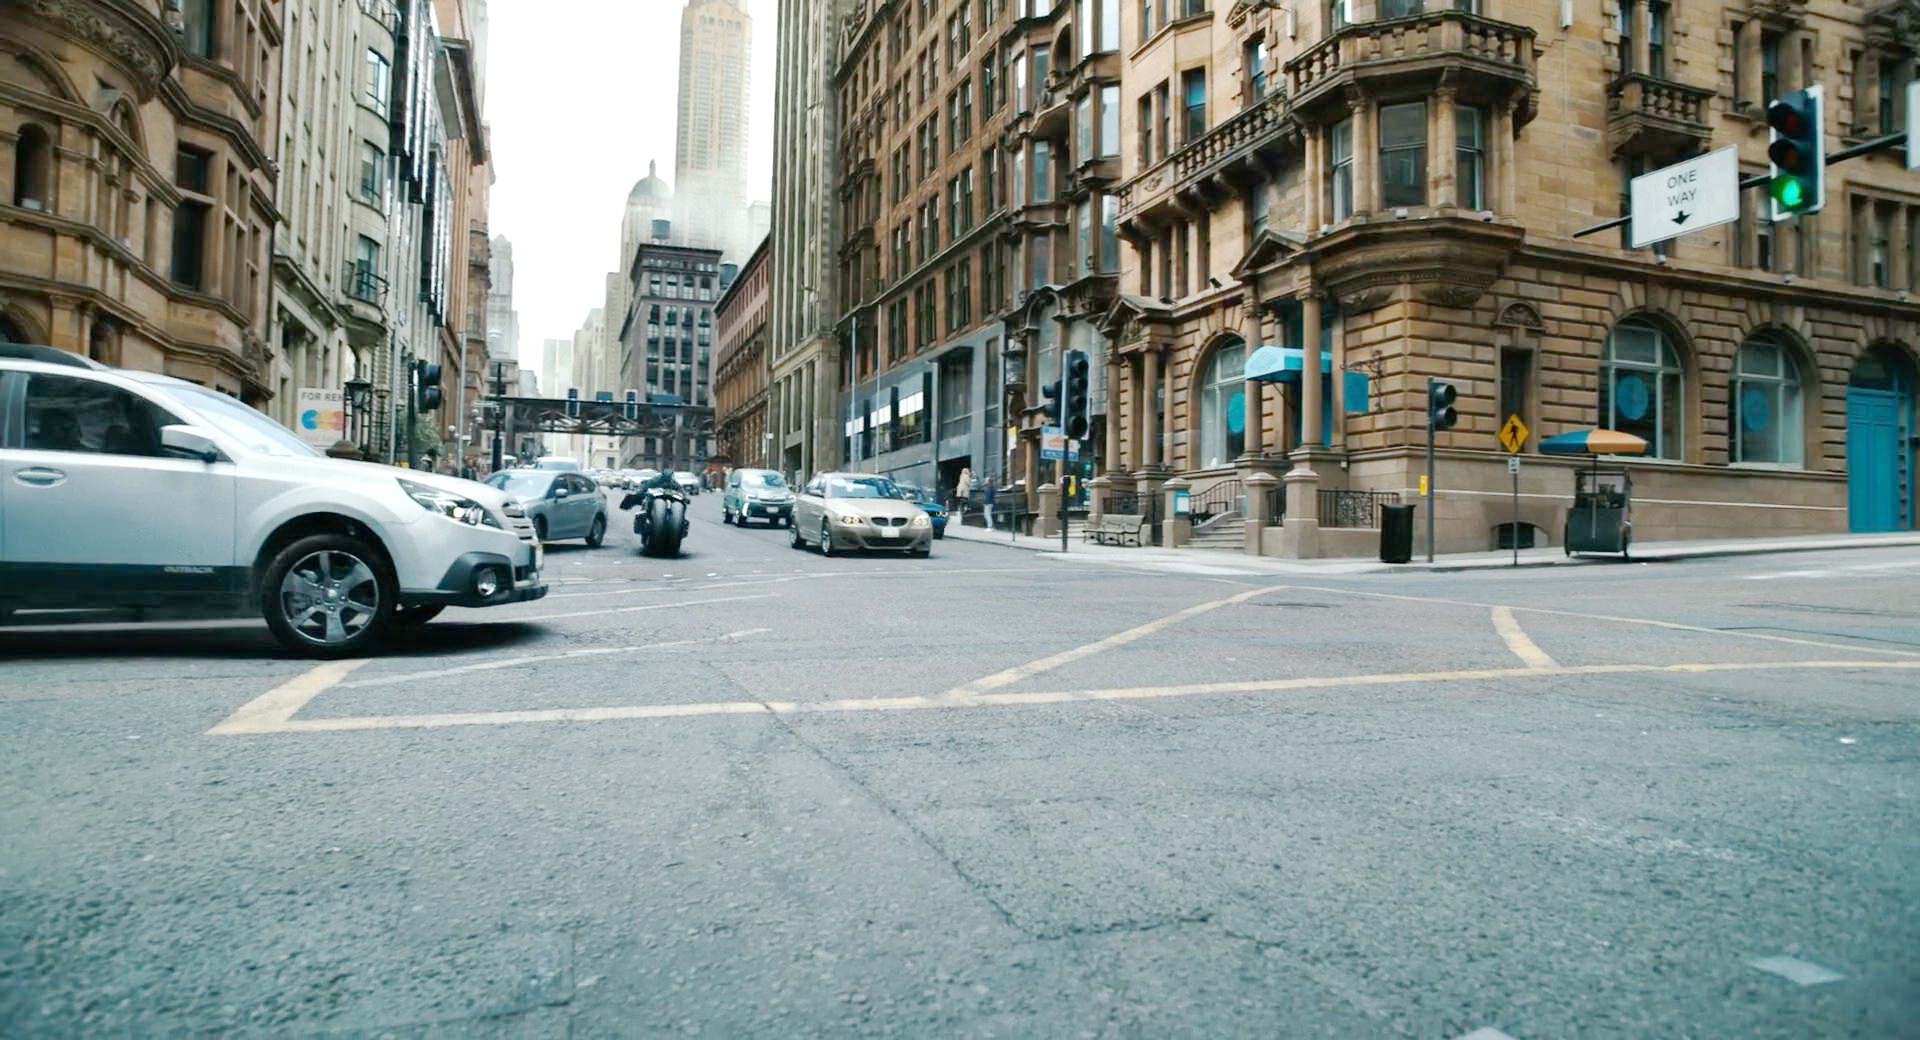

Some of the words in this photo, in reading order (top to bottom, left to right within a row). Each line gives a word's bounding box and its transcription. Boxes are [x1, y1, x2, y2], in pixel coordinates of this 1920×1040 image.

[1667, 169, 1697, 189] ONE
[1667, 188, 1697, 207] WAY
[301, 391, 321, 401] FOR
[325, 392, 345, 401] REN
